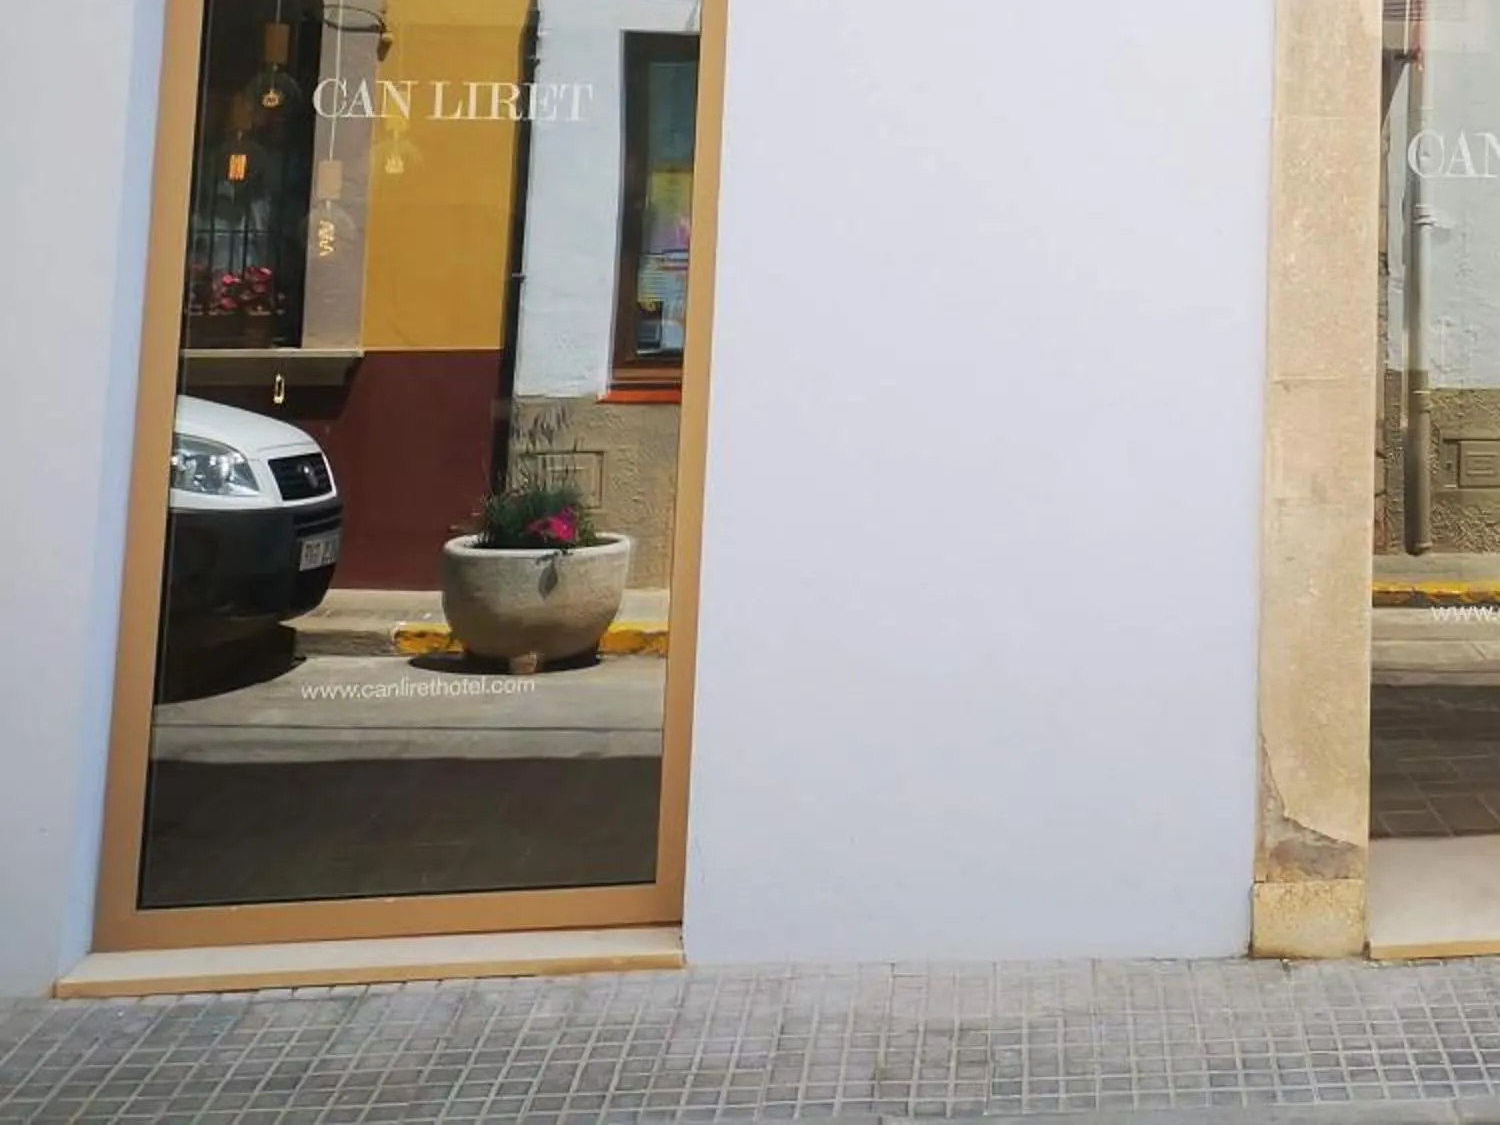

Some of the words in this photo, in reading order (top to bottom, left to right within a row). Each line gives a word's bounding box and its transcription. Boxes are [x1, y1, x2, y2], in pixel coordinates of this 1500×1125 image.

[312, 78, 418, 119] CAN
[428, 79, 594, 121] LIRET
[301, 676, 536, 700] www.canlirethotel.com
